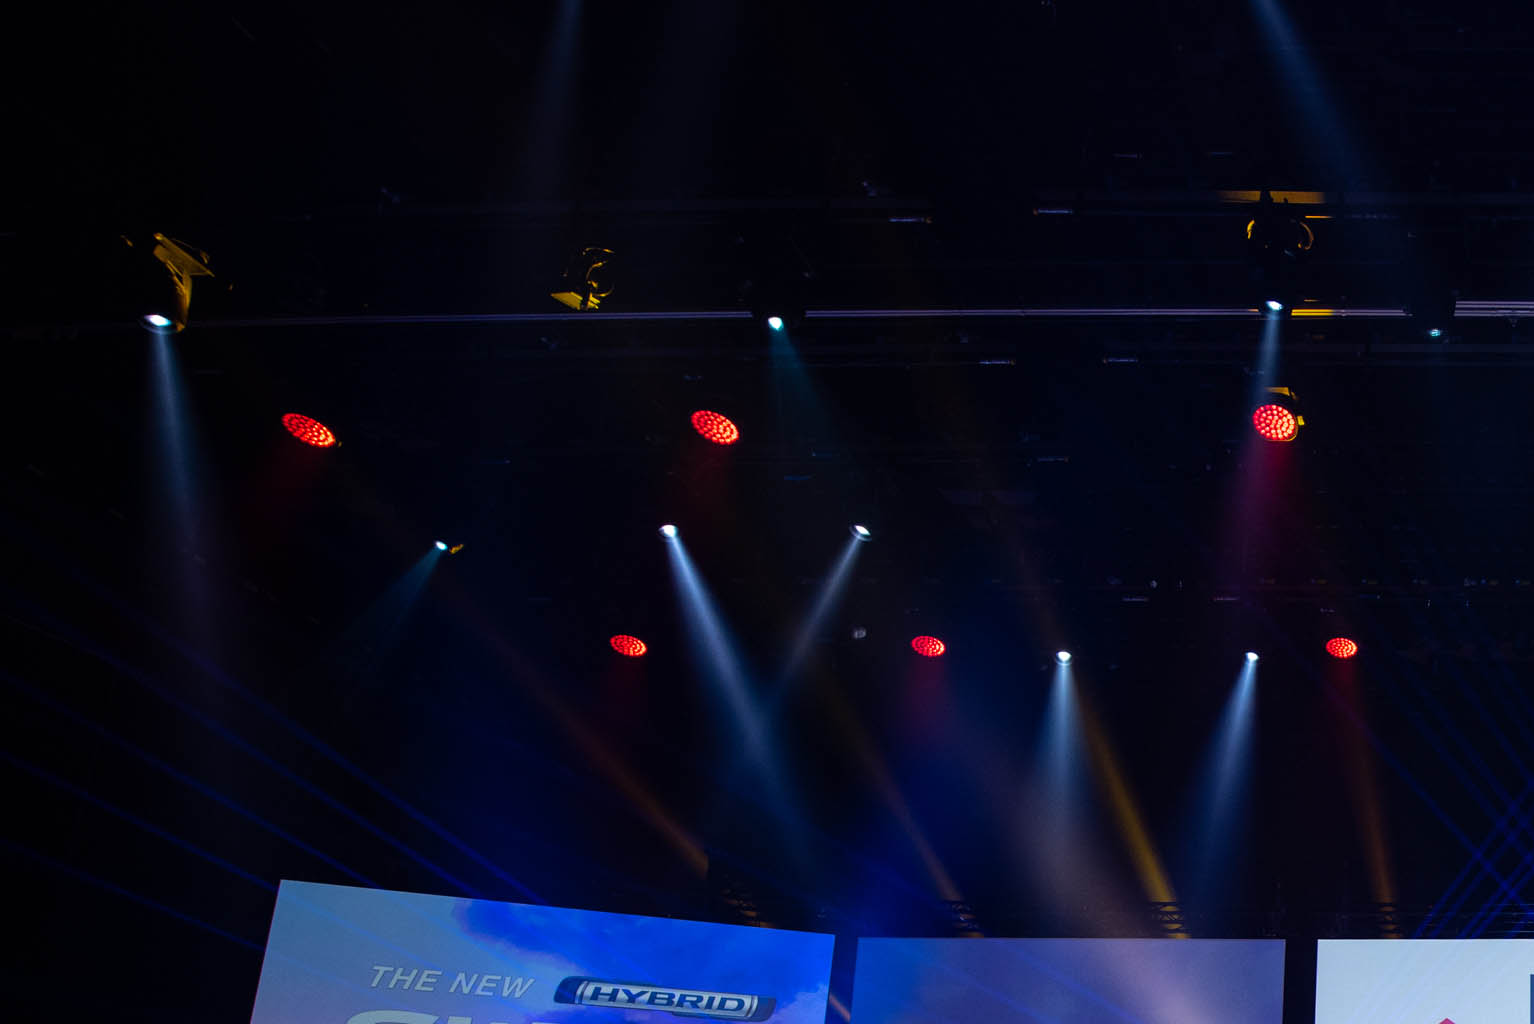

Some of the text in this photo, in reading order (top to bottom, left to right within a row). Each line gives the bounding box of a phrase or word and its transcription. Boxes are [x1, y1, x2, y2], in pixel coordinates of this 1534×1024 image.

[371, 966, 536, 998] THE NEW
[589, 985, 749, 1013] HYBRID
